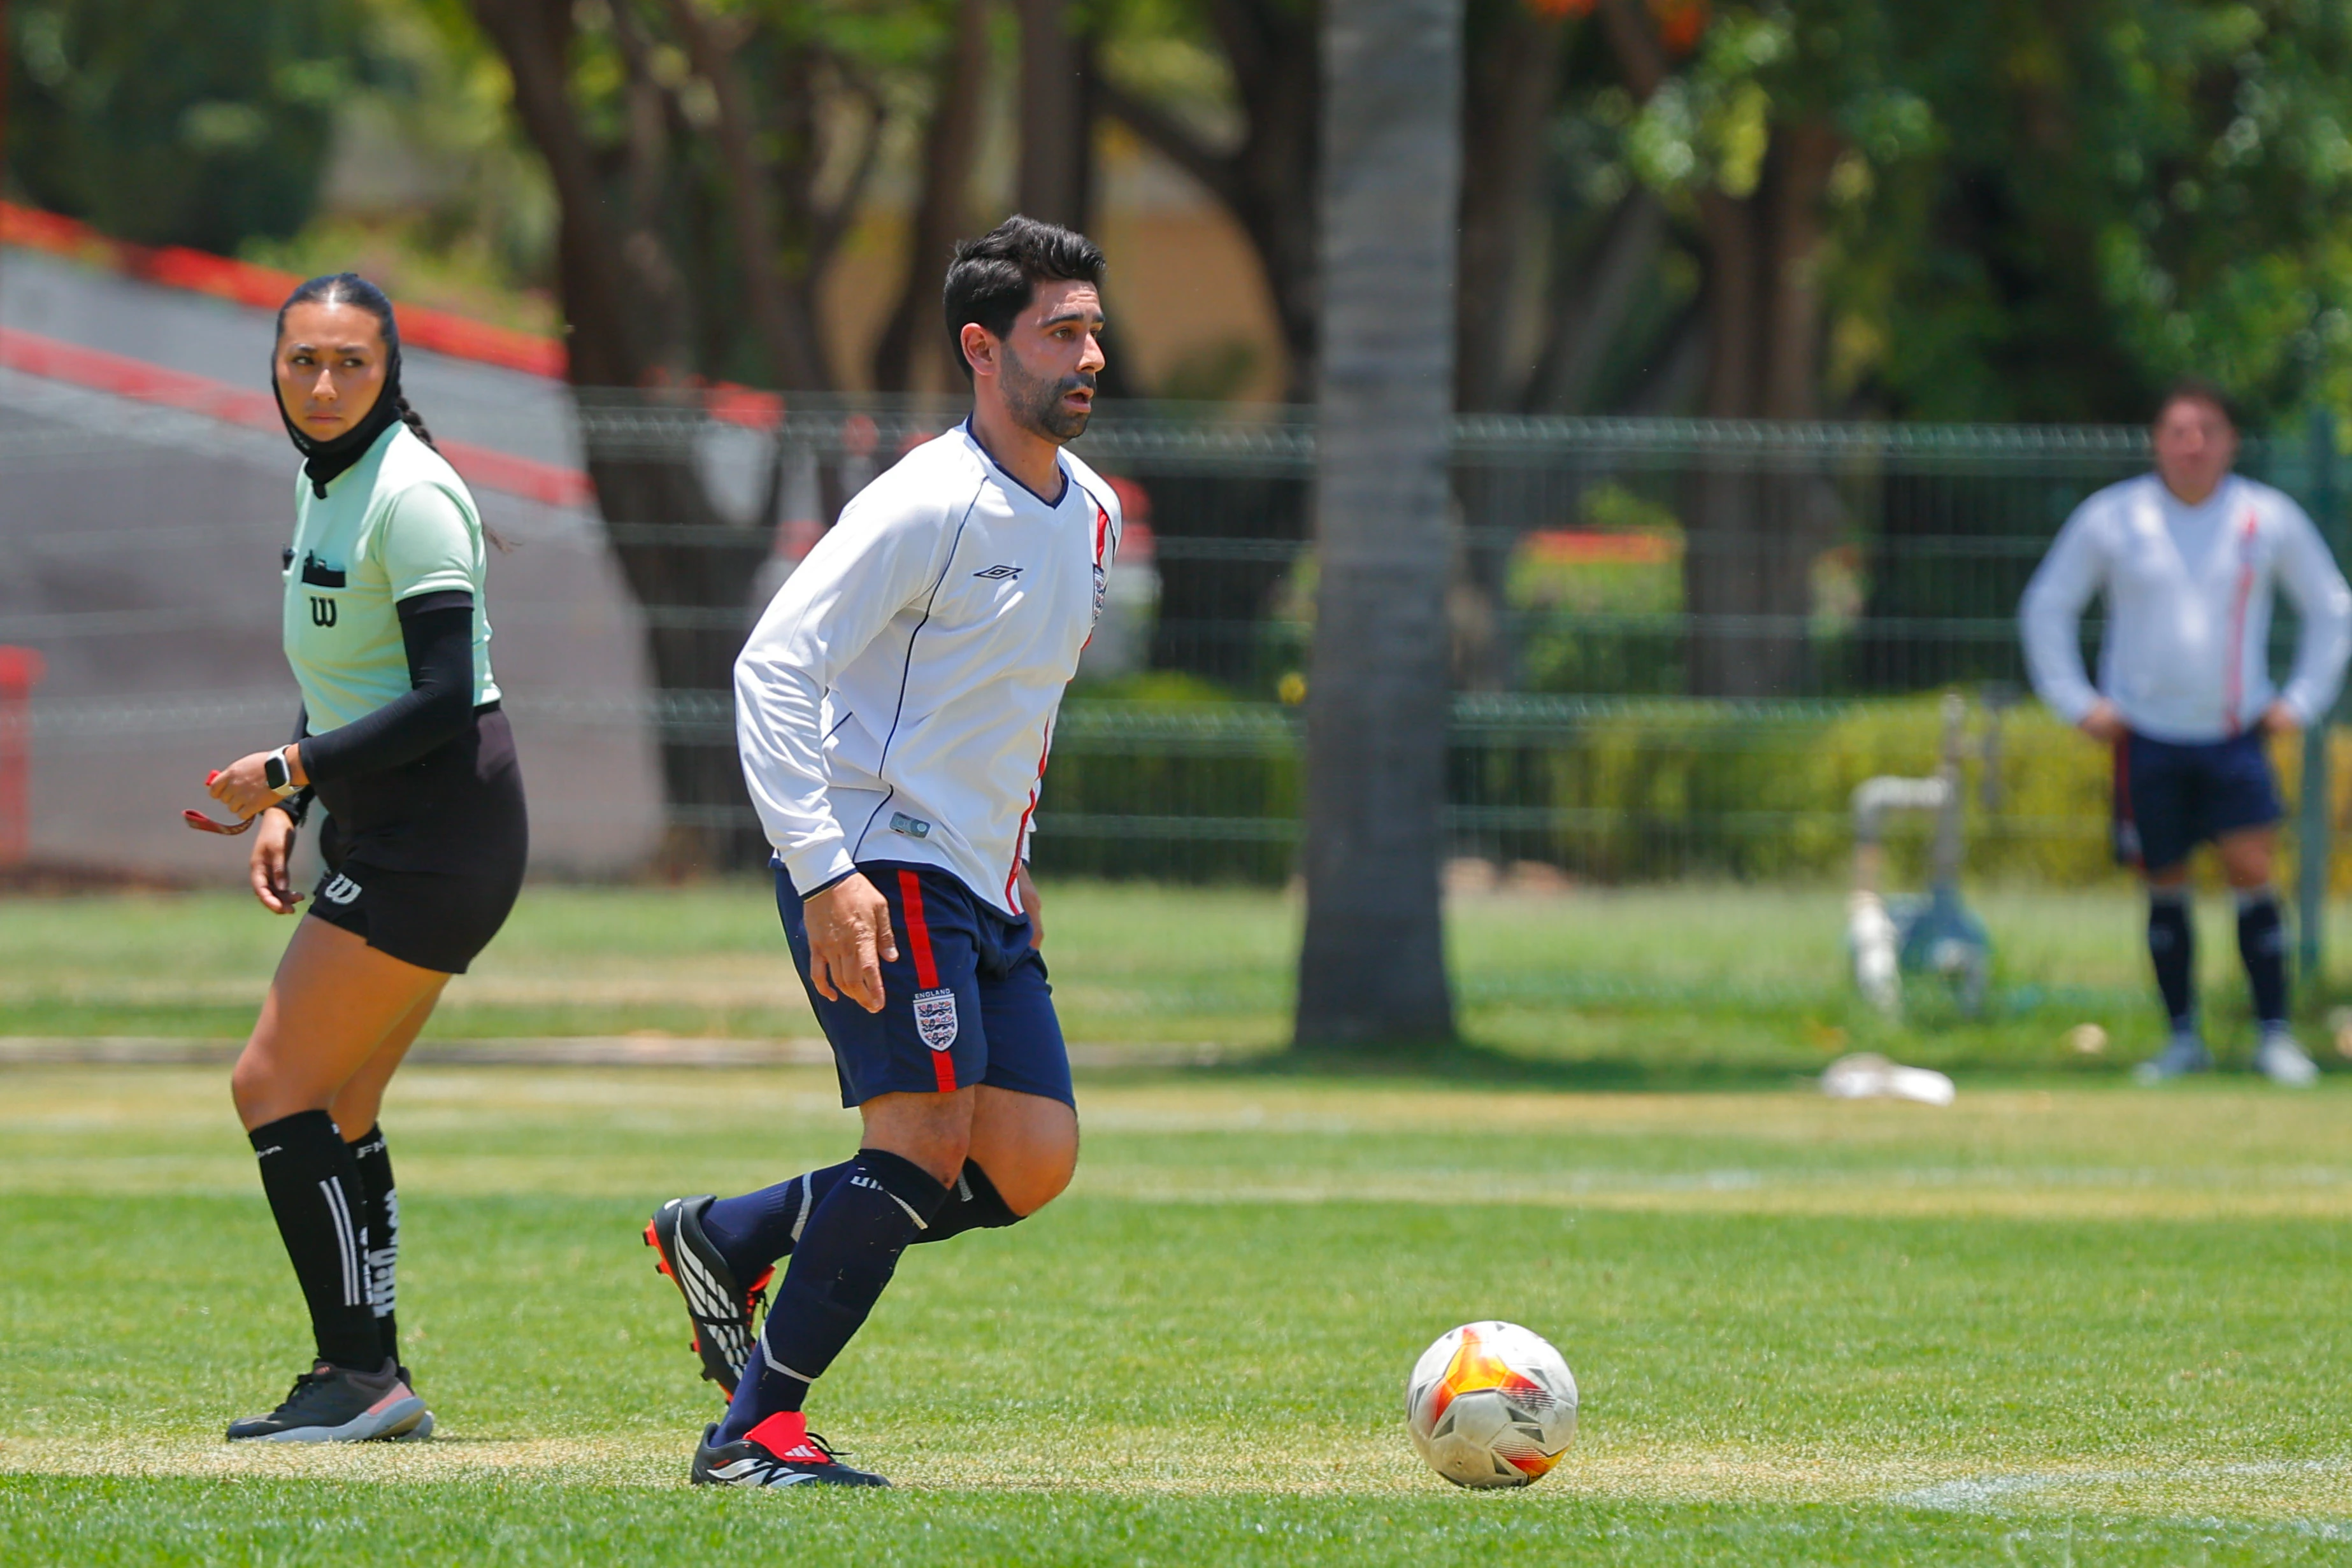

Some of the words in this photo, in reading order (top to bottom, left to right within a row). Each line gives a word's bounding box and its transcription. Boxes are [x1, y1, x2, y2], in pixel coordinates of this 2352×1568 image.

[310, 595, 337, 627] W
[325, 873, 362, 904] W
[915, 988, 950, 999] ENGLAND
